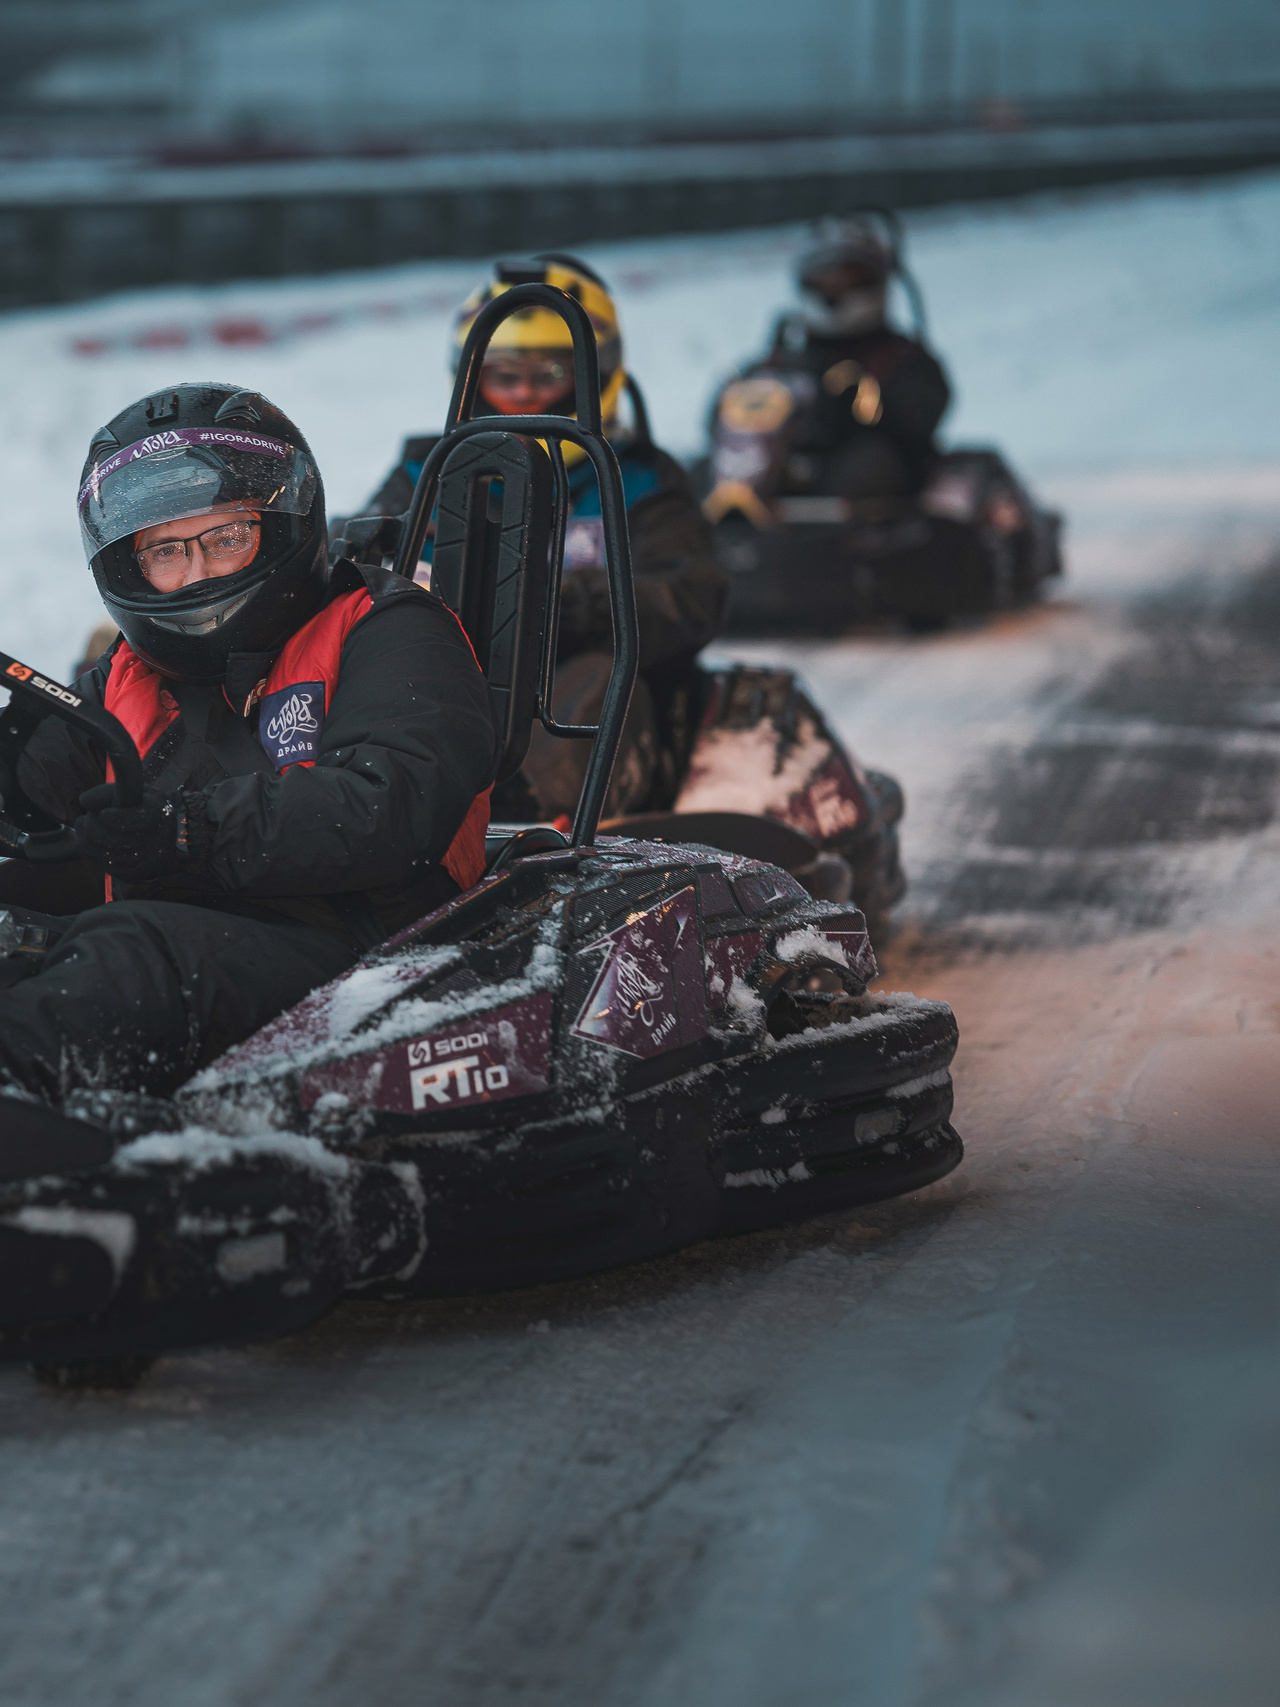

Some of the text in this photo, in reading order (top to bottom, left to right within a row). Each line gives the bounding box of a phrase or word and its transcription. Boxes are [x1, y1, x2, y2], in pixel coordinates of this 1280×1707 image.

[199, 432, 285, 455] #IGORADRIVE
[30, 675, 82, 707] SODI
[277, 741, 313, 757] ДРАЙВ
[651, 1012, 676, 1046] ДРАЙВ
[434, 1031, 488, 1056] SODI
